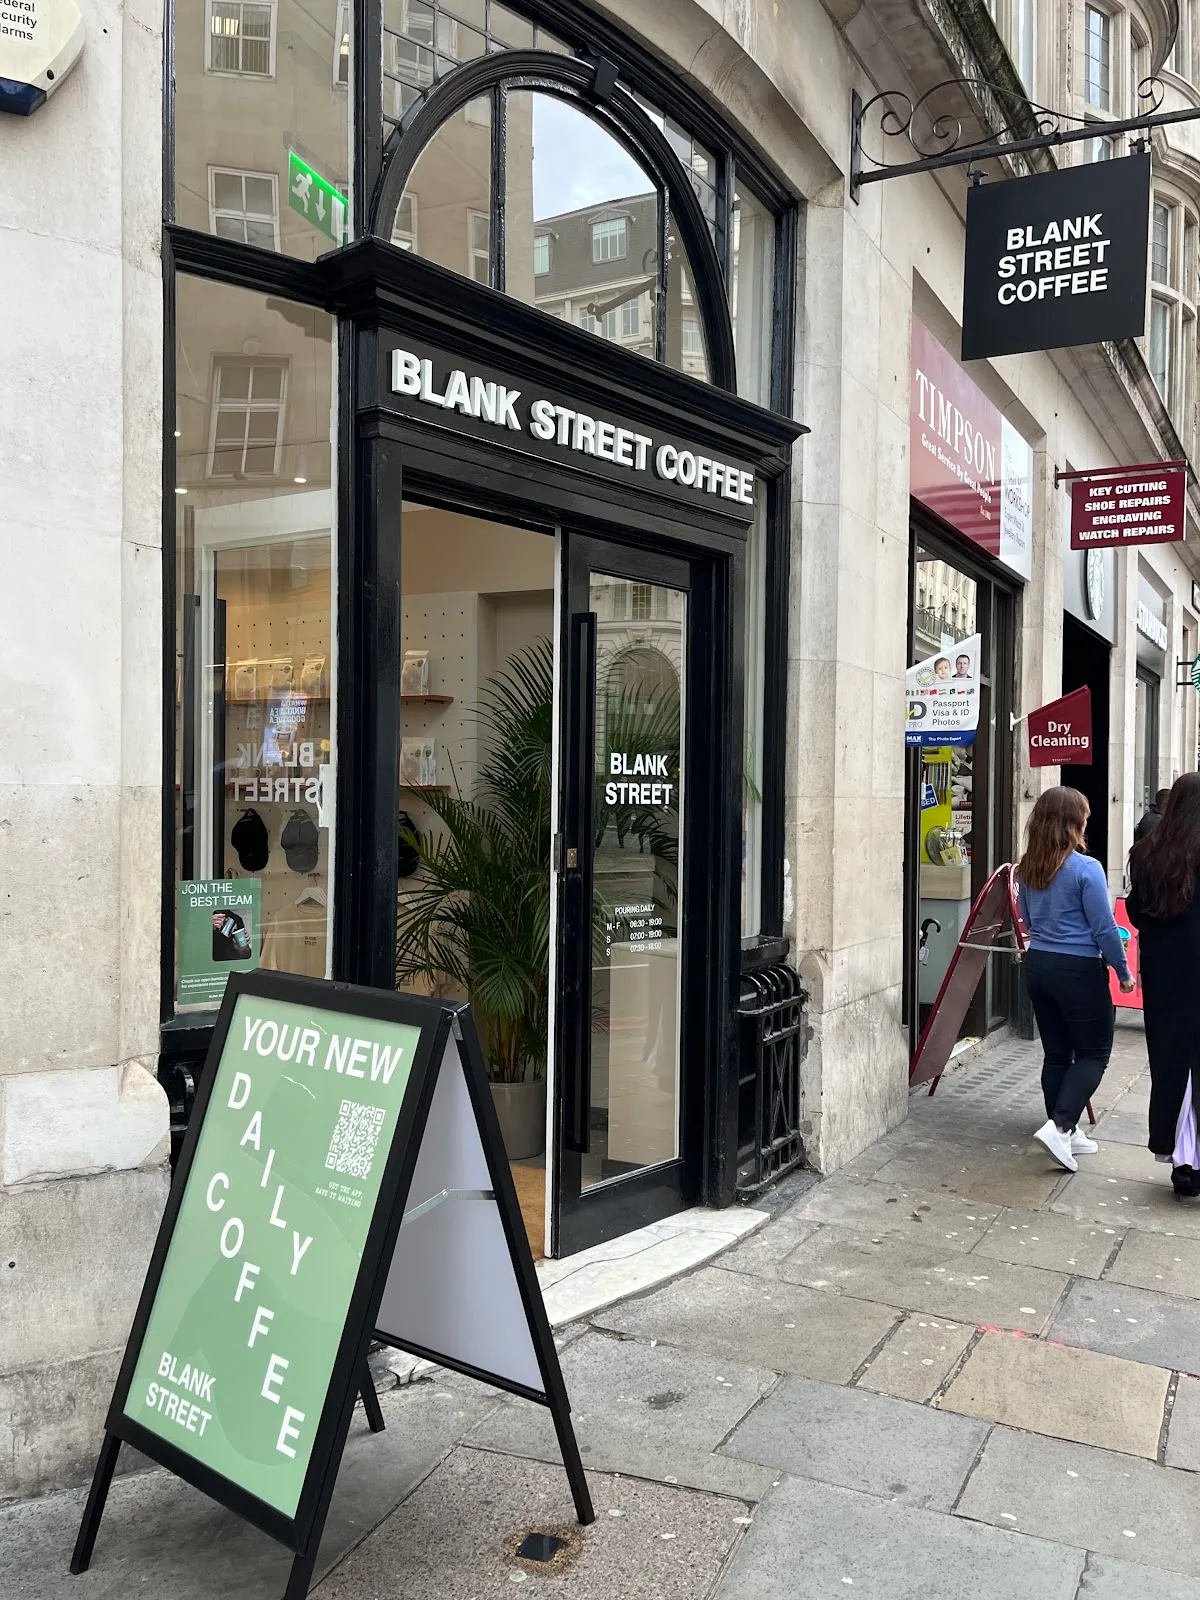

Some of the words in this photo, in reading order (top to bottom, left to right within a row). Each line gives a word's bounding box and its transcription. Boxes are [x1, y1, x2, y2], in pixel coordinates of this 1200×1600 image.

[0, 12, 37, 29] curity
[1006, 213, 1103, 251] BLANK
[997, 239, 1111, 278] STREET
[997, 268, 1108, 305] COFFEE
[391, 348, 522, 431] BLANK
[529, 399, 652, 471] STREET
[655, 444, 754, 505] COFFEE
[916, 368, 996, 486] TIMPSON
[1089, 486, 1112, 497] KEY
[1115, 481, 1167, 495] CUTTING
[1084, 501, 1116, 512] SHOE
[1119, 495, 1171, 509] REPAIRS
[1092, 511, 1162, 525] ENGRAVING
[1079, 529, 1120, 540] WATCH
[1123, 524, 1175, 537] REPAIRS
[932, 699, 970, 708] Passport
[960, 708, 970, 716] ID
[932, 718, 960, 726] Photos
[1047, 721, 1072, 735] Dry
[1030, 734, 1089, 749] Cleaning
[610, 752, 669, 777] BLANK
[605, 782, 673, 805] STREET
[181, 884, 208, 895] JOIN
[210, 882, 233, 893] THE
[190, 896, 220, 907] BEST
[221, 894, 253, 906] TEAM
[614, 904, 640, 915] POURING
[640, 903, 656, 913] DAILY
[242, 1016, 321, 1067] YOUR
[323, 1035, 404, 1085] NEW
[227, 1071, 314, 1275] DAILY
[206, 1172, 306, 1459] COFFEE
[157, 1351, 217, 1403] BLANK
[145, 1382, 213, 1437] STREET
